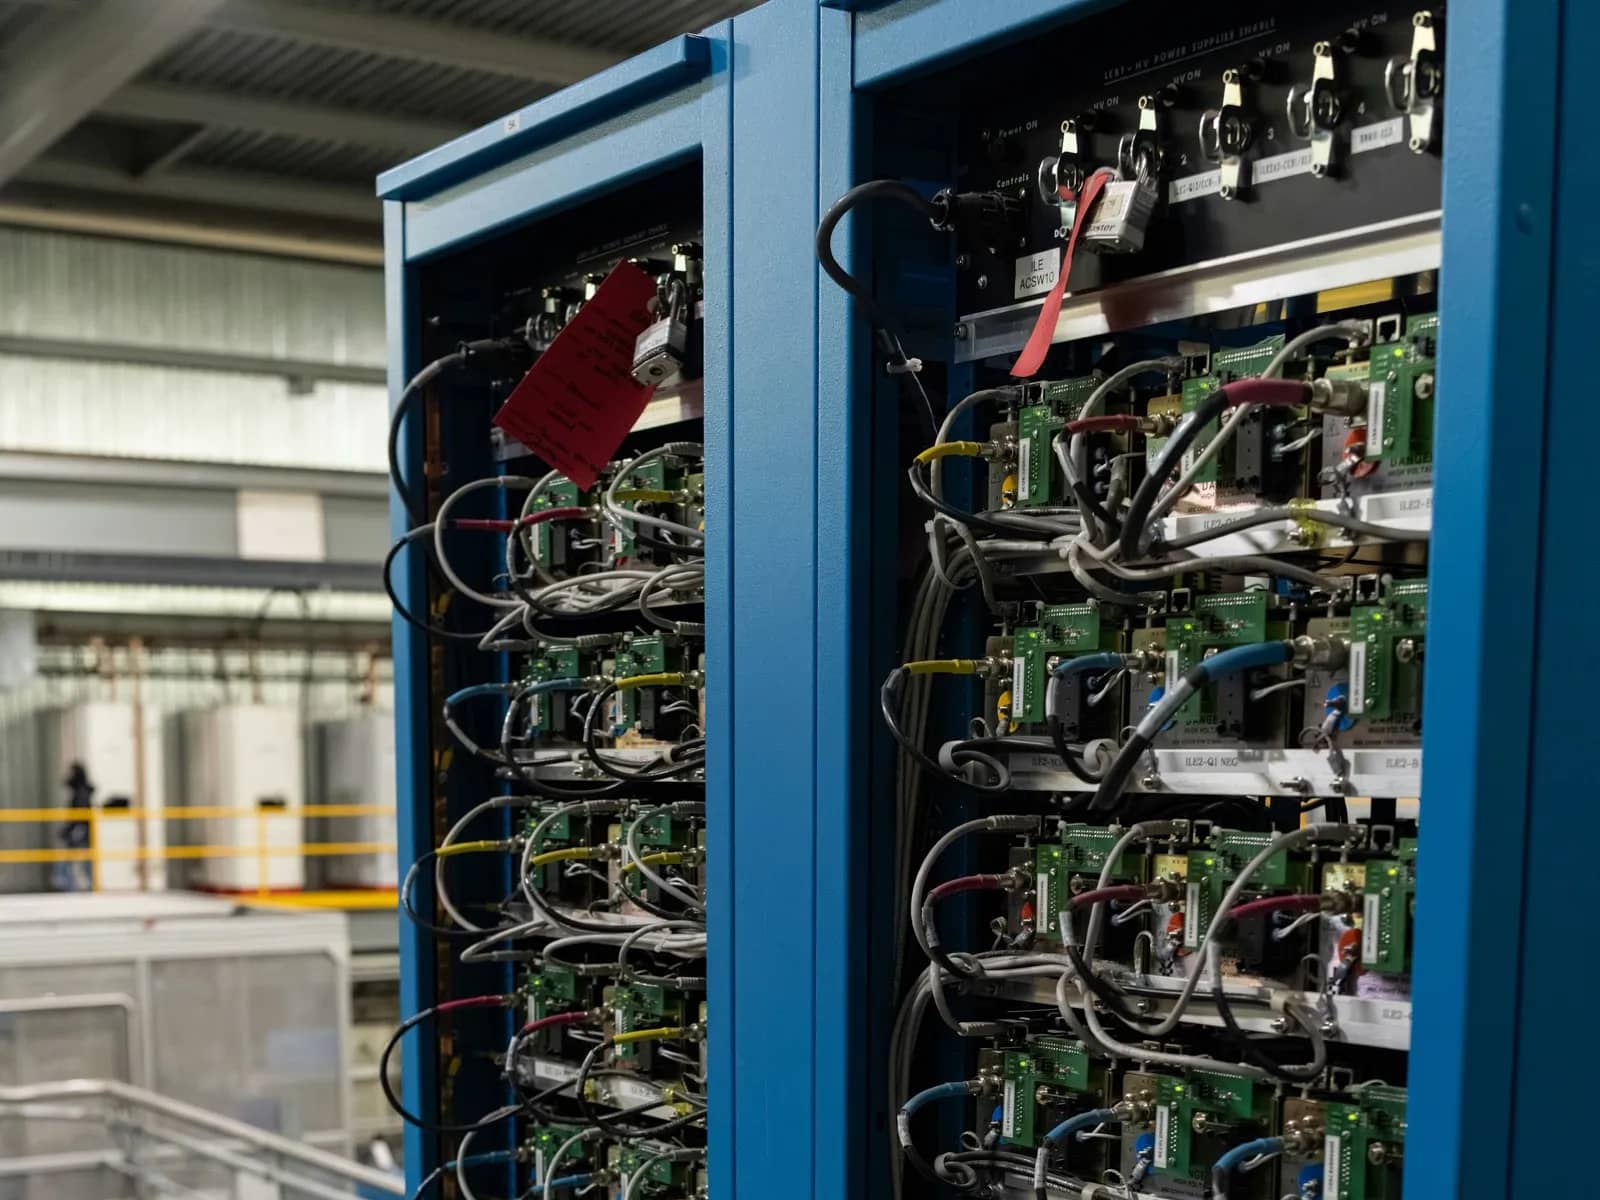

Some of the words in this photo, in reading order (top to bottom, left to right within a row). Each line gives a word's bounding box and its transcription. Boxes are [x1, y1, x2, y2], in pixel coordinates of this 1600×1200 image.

[1371, 12, 1387, 25] ON
[1275, 42, 1291, 54] ON
[1187, 69, 1201, 81] ON
[1093, 100, 1105, 111] HV
[1106, 96, 1119, 107] ON
[1025, 119, 1038, 131] ON
[1181, 153, 1188, 166] 2
[996, 172, 1030, 189] Controls
[1032, 258, 1044, 273] ILE
[1019, 271, 1055, 291] ACSW10
[1220, 756, 1238, 768] NEG
